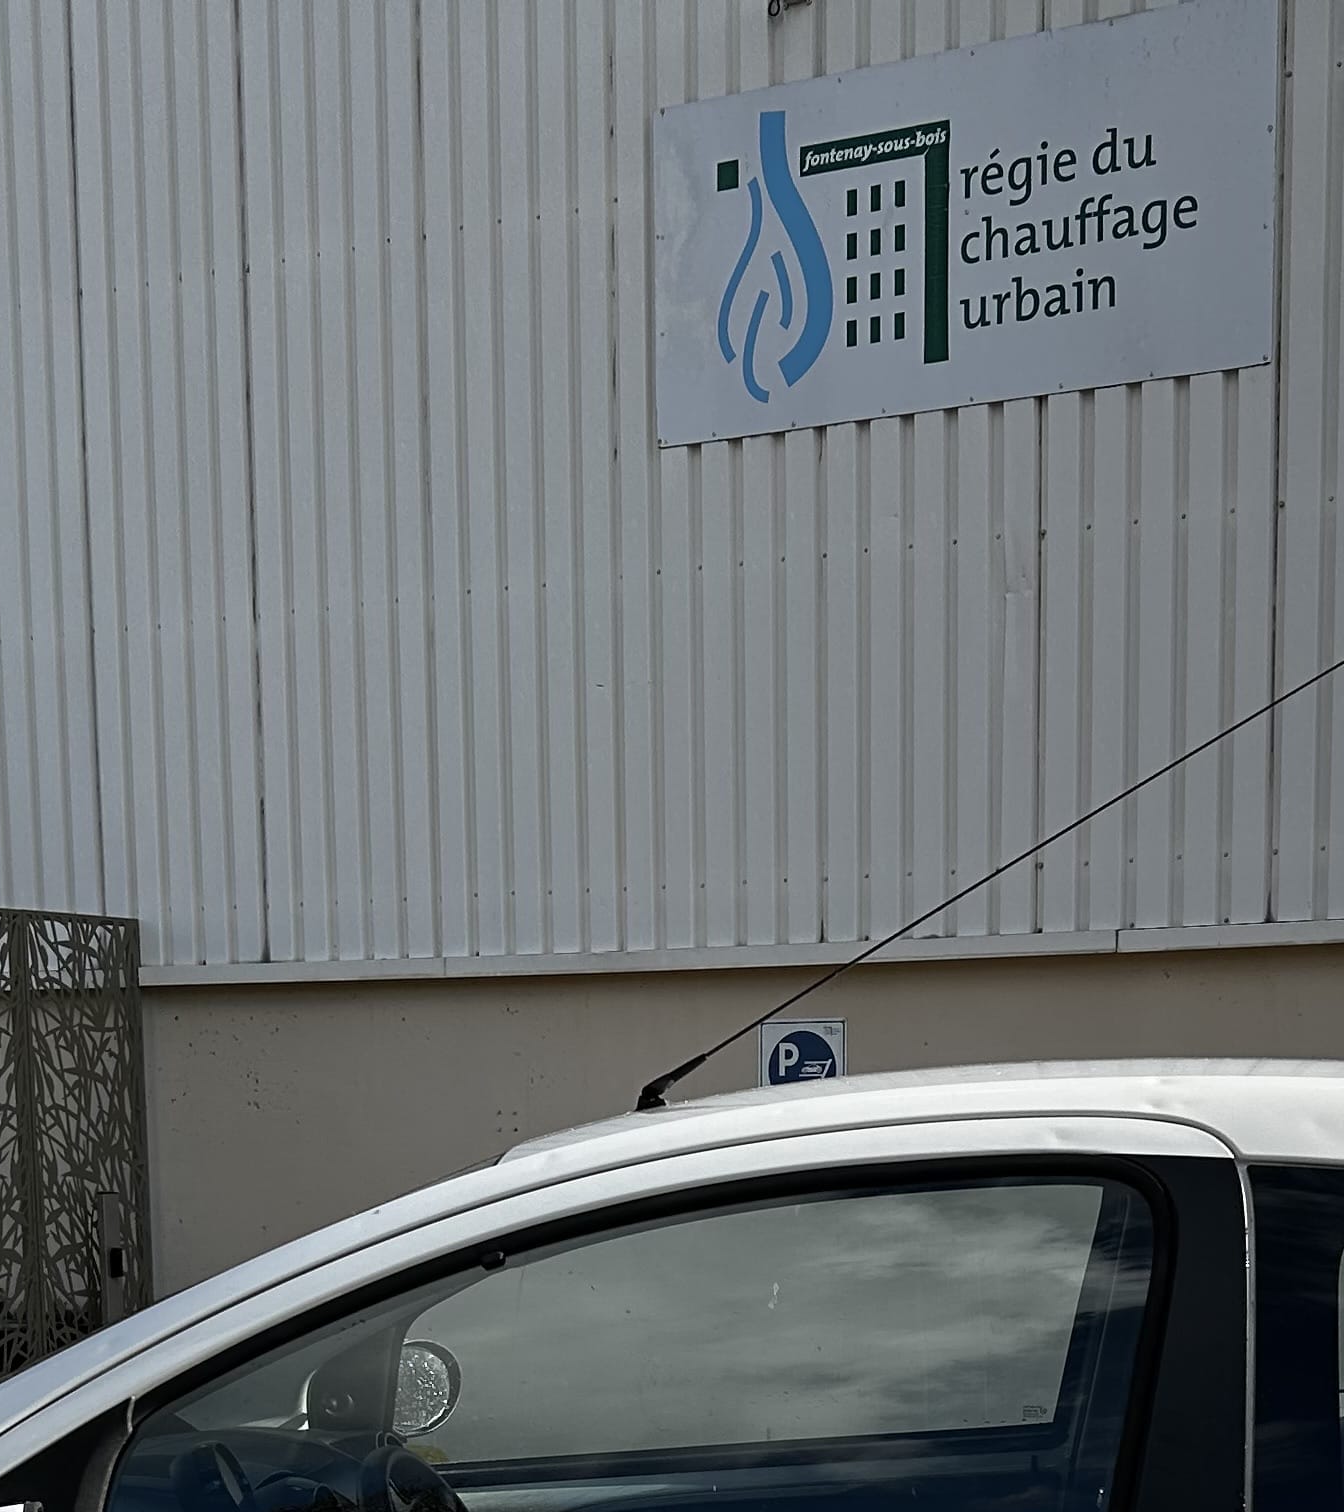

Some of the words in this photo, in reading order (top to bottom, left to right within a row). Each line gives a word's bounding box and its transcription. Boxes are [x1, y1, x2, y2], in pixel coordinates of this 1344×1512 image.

[802, 128, 947, 172] fontenay-sous-bois
[960, 141, 1077, 206] régie
[1092, 127, 1157, 175] du
[960, 193, 1199, 264] chauffage
[959, 268, 1116, 329] urbain
[778, 1042, 800, 1077] P
